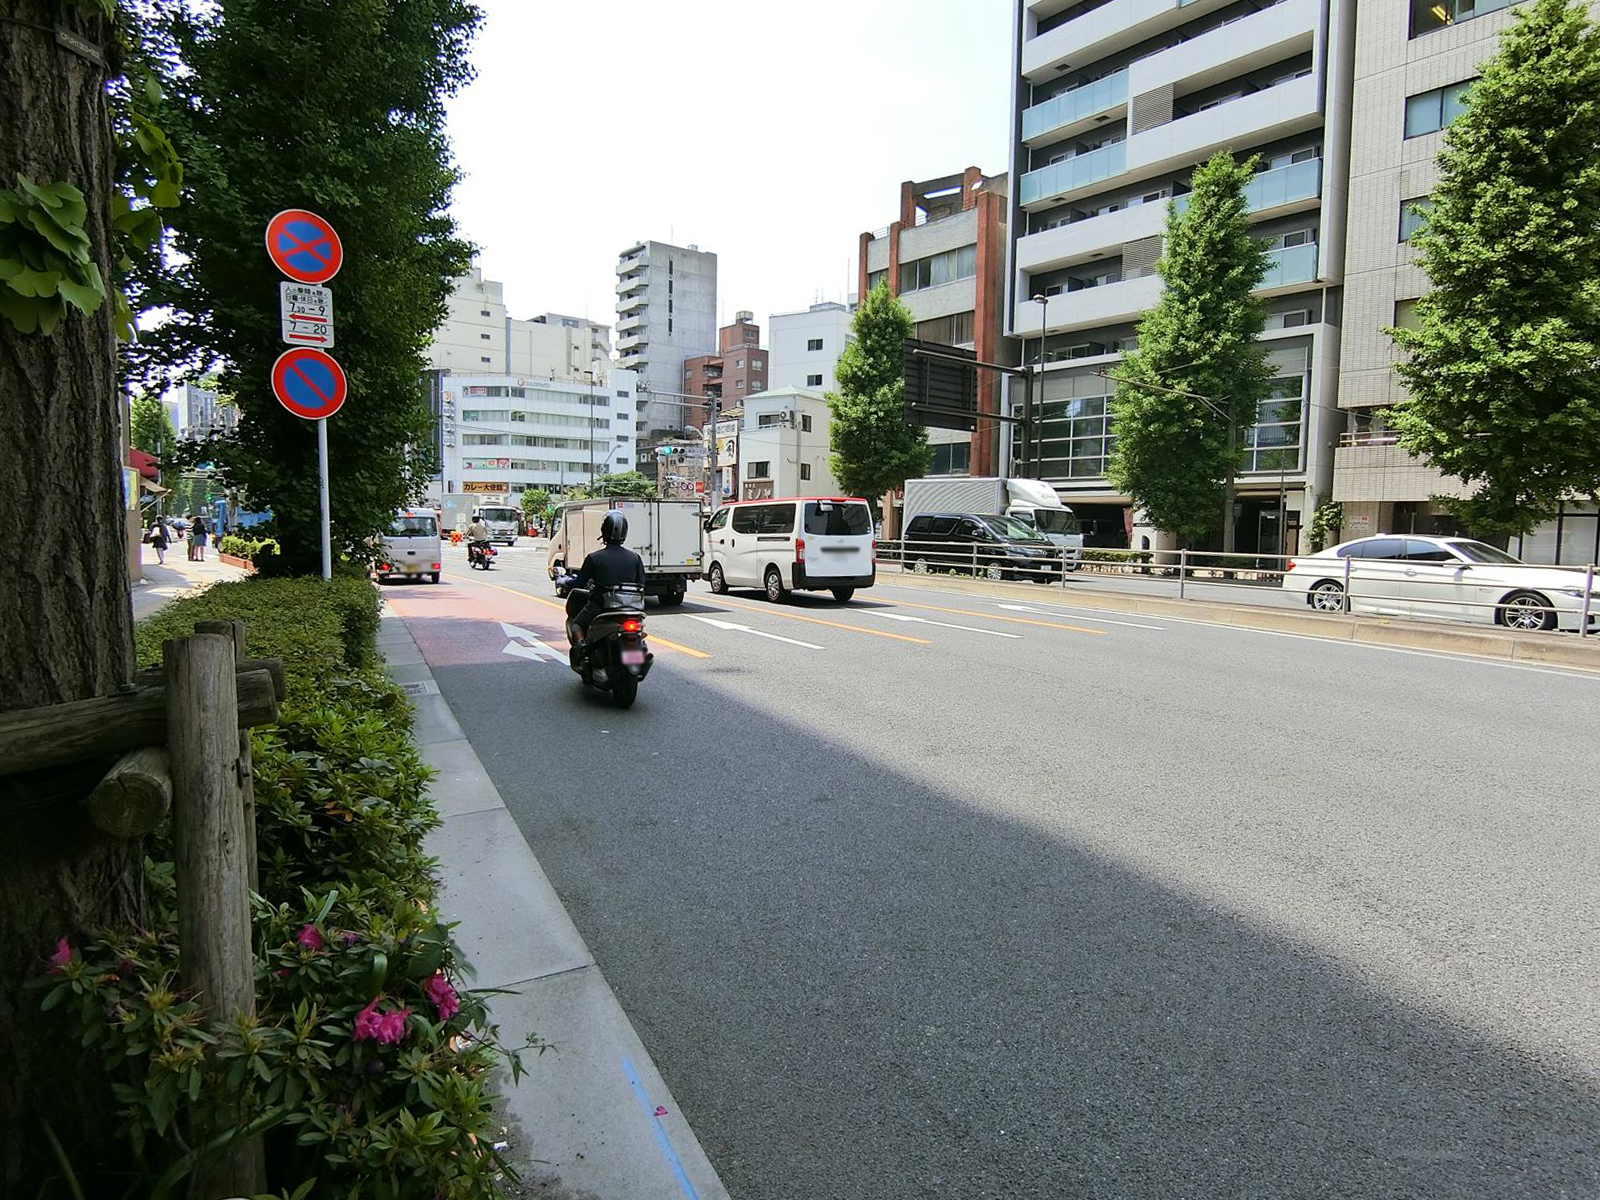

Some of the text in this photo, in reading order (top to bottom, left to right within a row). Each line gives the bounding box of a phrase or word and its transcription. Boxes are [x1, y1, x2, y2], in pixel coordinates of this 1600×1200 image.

[463, 483, 503, 492] カレー大使館
